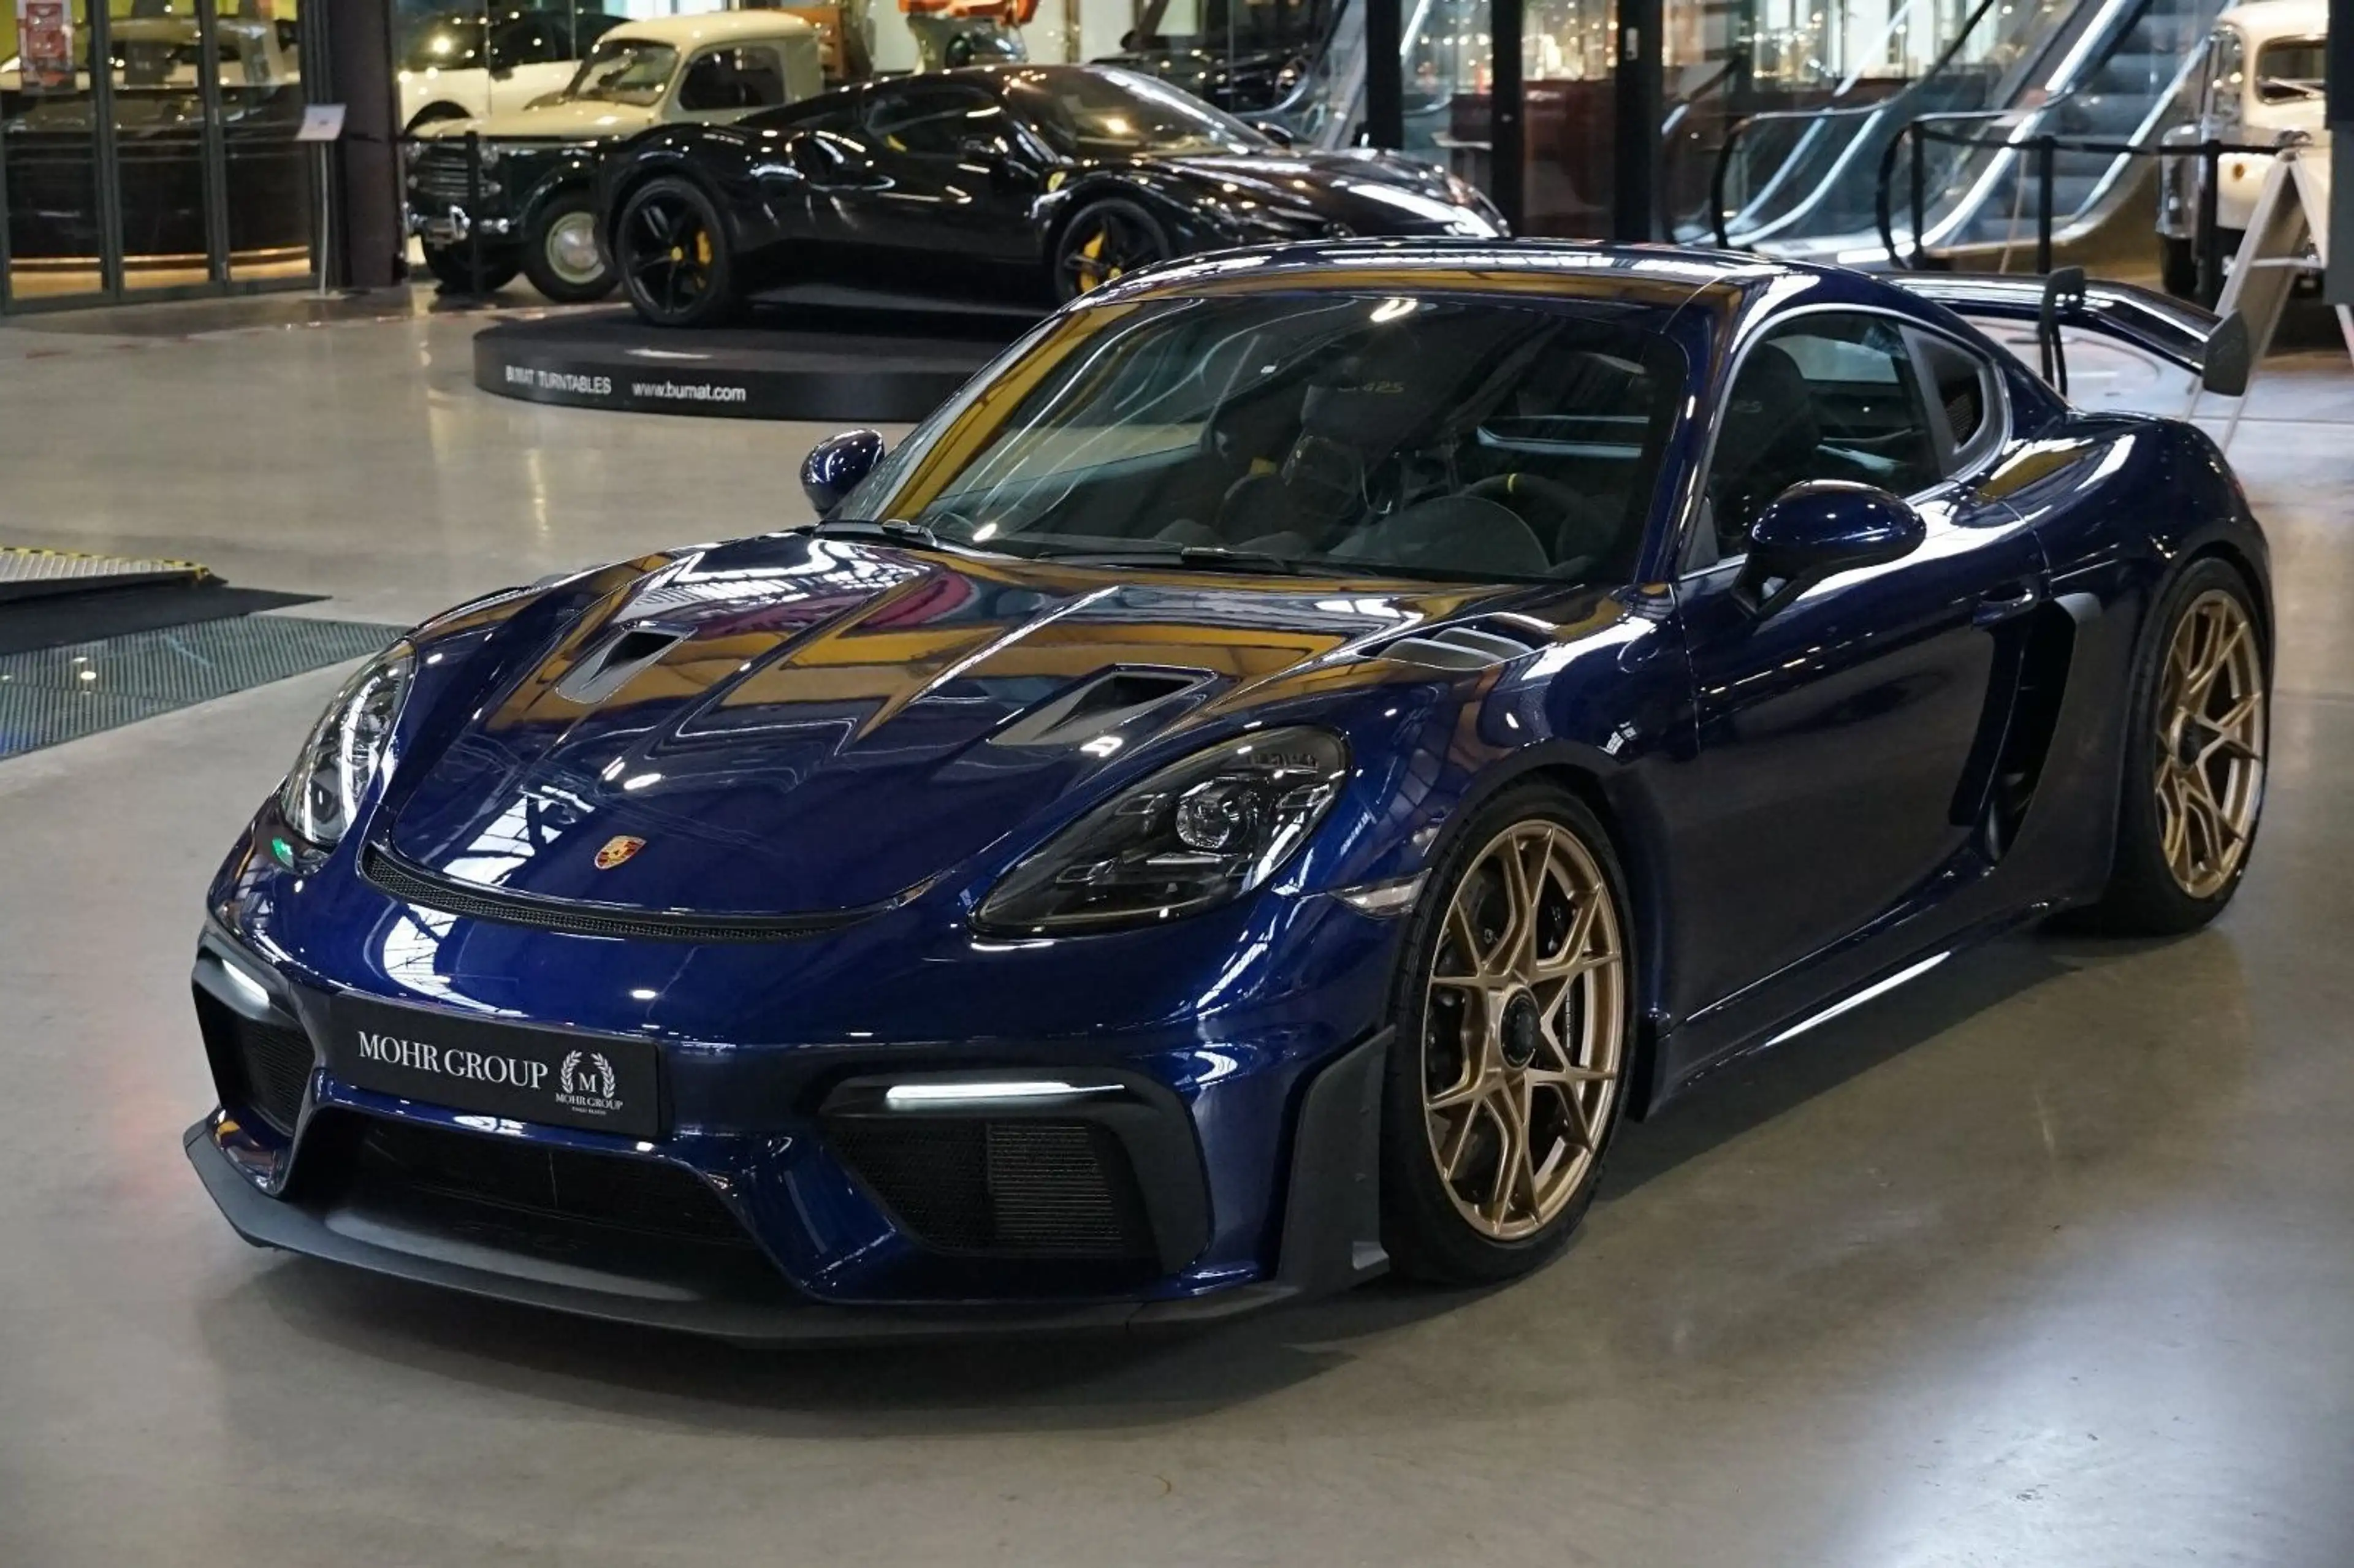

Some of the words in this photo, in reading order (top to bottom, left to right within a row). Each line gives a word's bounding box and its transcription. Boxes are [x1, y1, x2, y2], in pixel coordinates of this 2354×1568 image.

[538, 370, 612, 395] TURNTABLES
[632, 381, 746, 402] www.bumat.com
[358, 1031, 441, 1073] MOHR
[444, 1049, 548, 1089] GROUP
[579, 1073, 596, 1092] M
[555, 1093, 587, 1106] MOHR
[587, 1097, 623, 1110] GROUP
